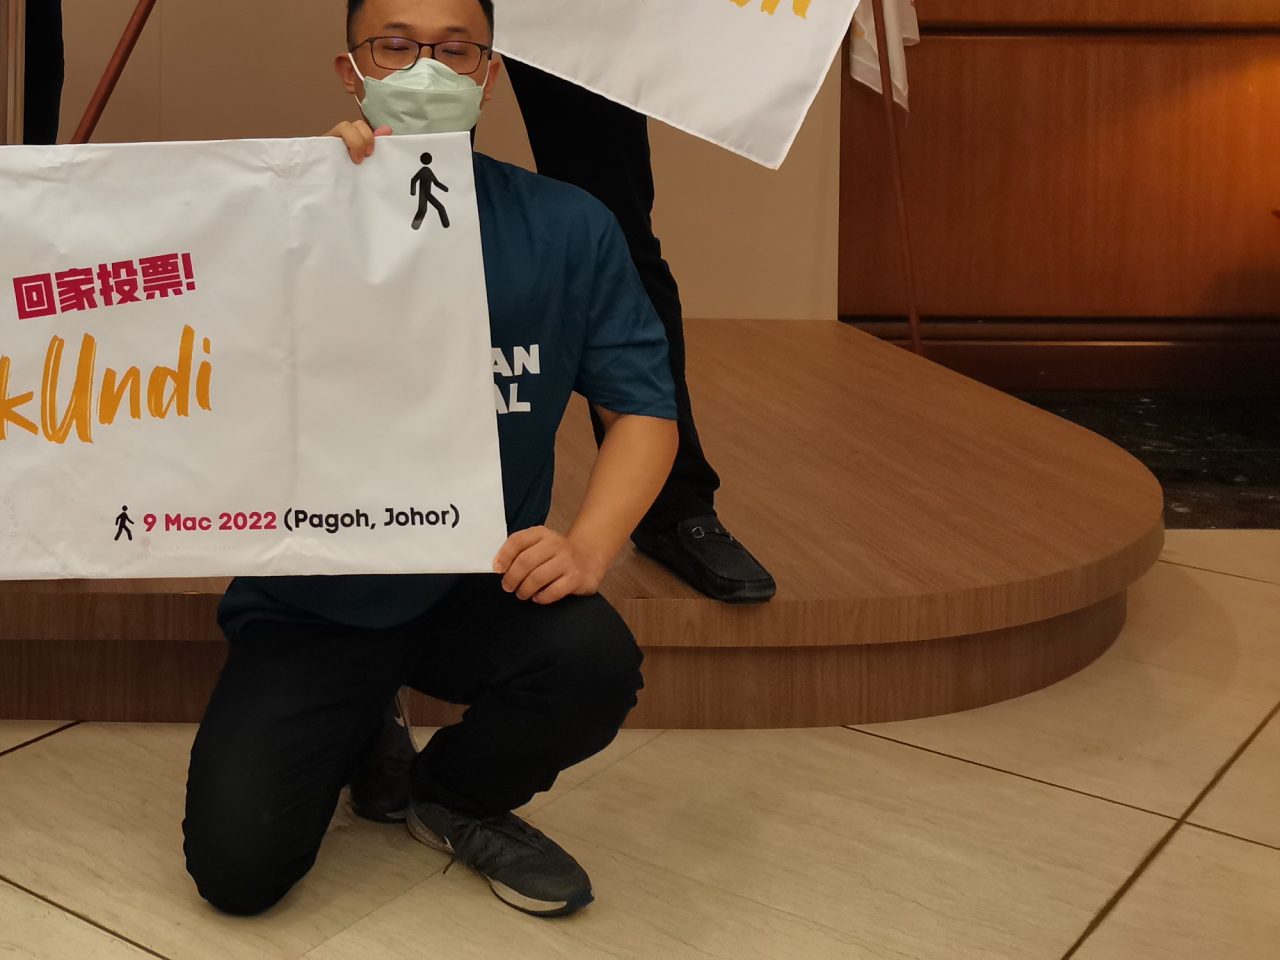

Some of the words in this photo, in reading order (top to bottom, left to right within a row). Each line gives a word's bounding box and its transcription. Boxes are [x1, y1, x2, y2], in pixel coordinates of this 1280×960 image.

[12, 252, 196, 320] 回家投票!
[143, 513, 157, 532] 9
[164, 512, 212, 531] Mac
[218, 511, 277, 530] 2022
[284, 507, 376, 534] (Pagoh,
[384, 504, 460, 529] Johor)
